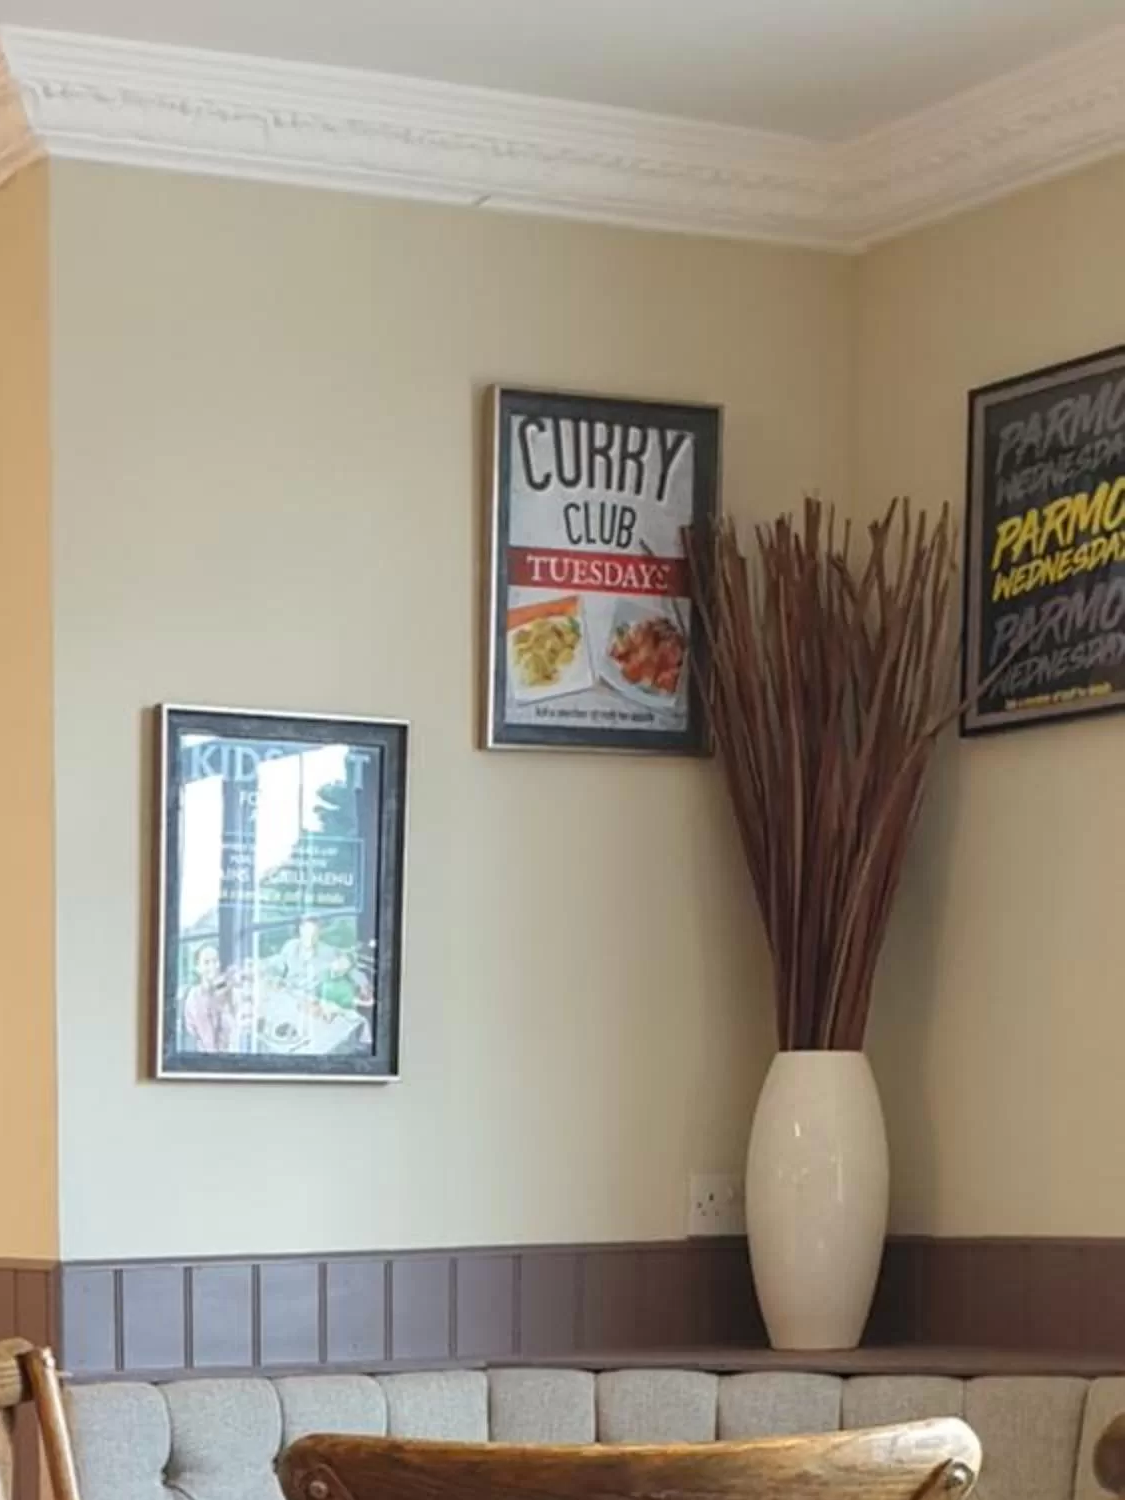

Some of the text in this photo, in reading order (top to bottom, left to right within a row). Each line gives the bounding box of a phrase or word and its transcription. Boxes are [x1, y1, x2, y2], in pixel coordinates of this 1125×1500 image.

[518, 417, 689, 502] CURRY
[562, 501, 637, 549] CLUB
[991, 476, 1125, 571] PARMO
[526, 553, 672, 590] TUESDAYS
